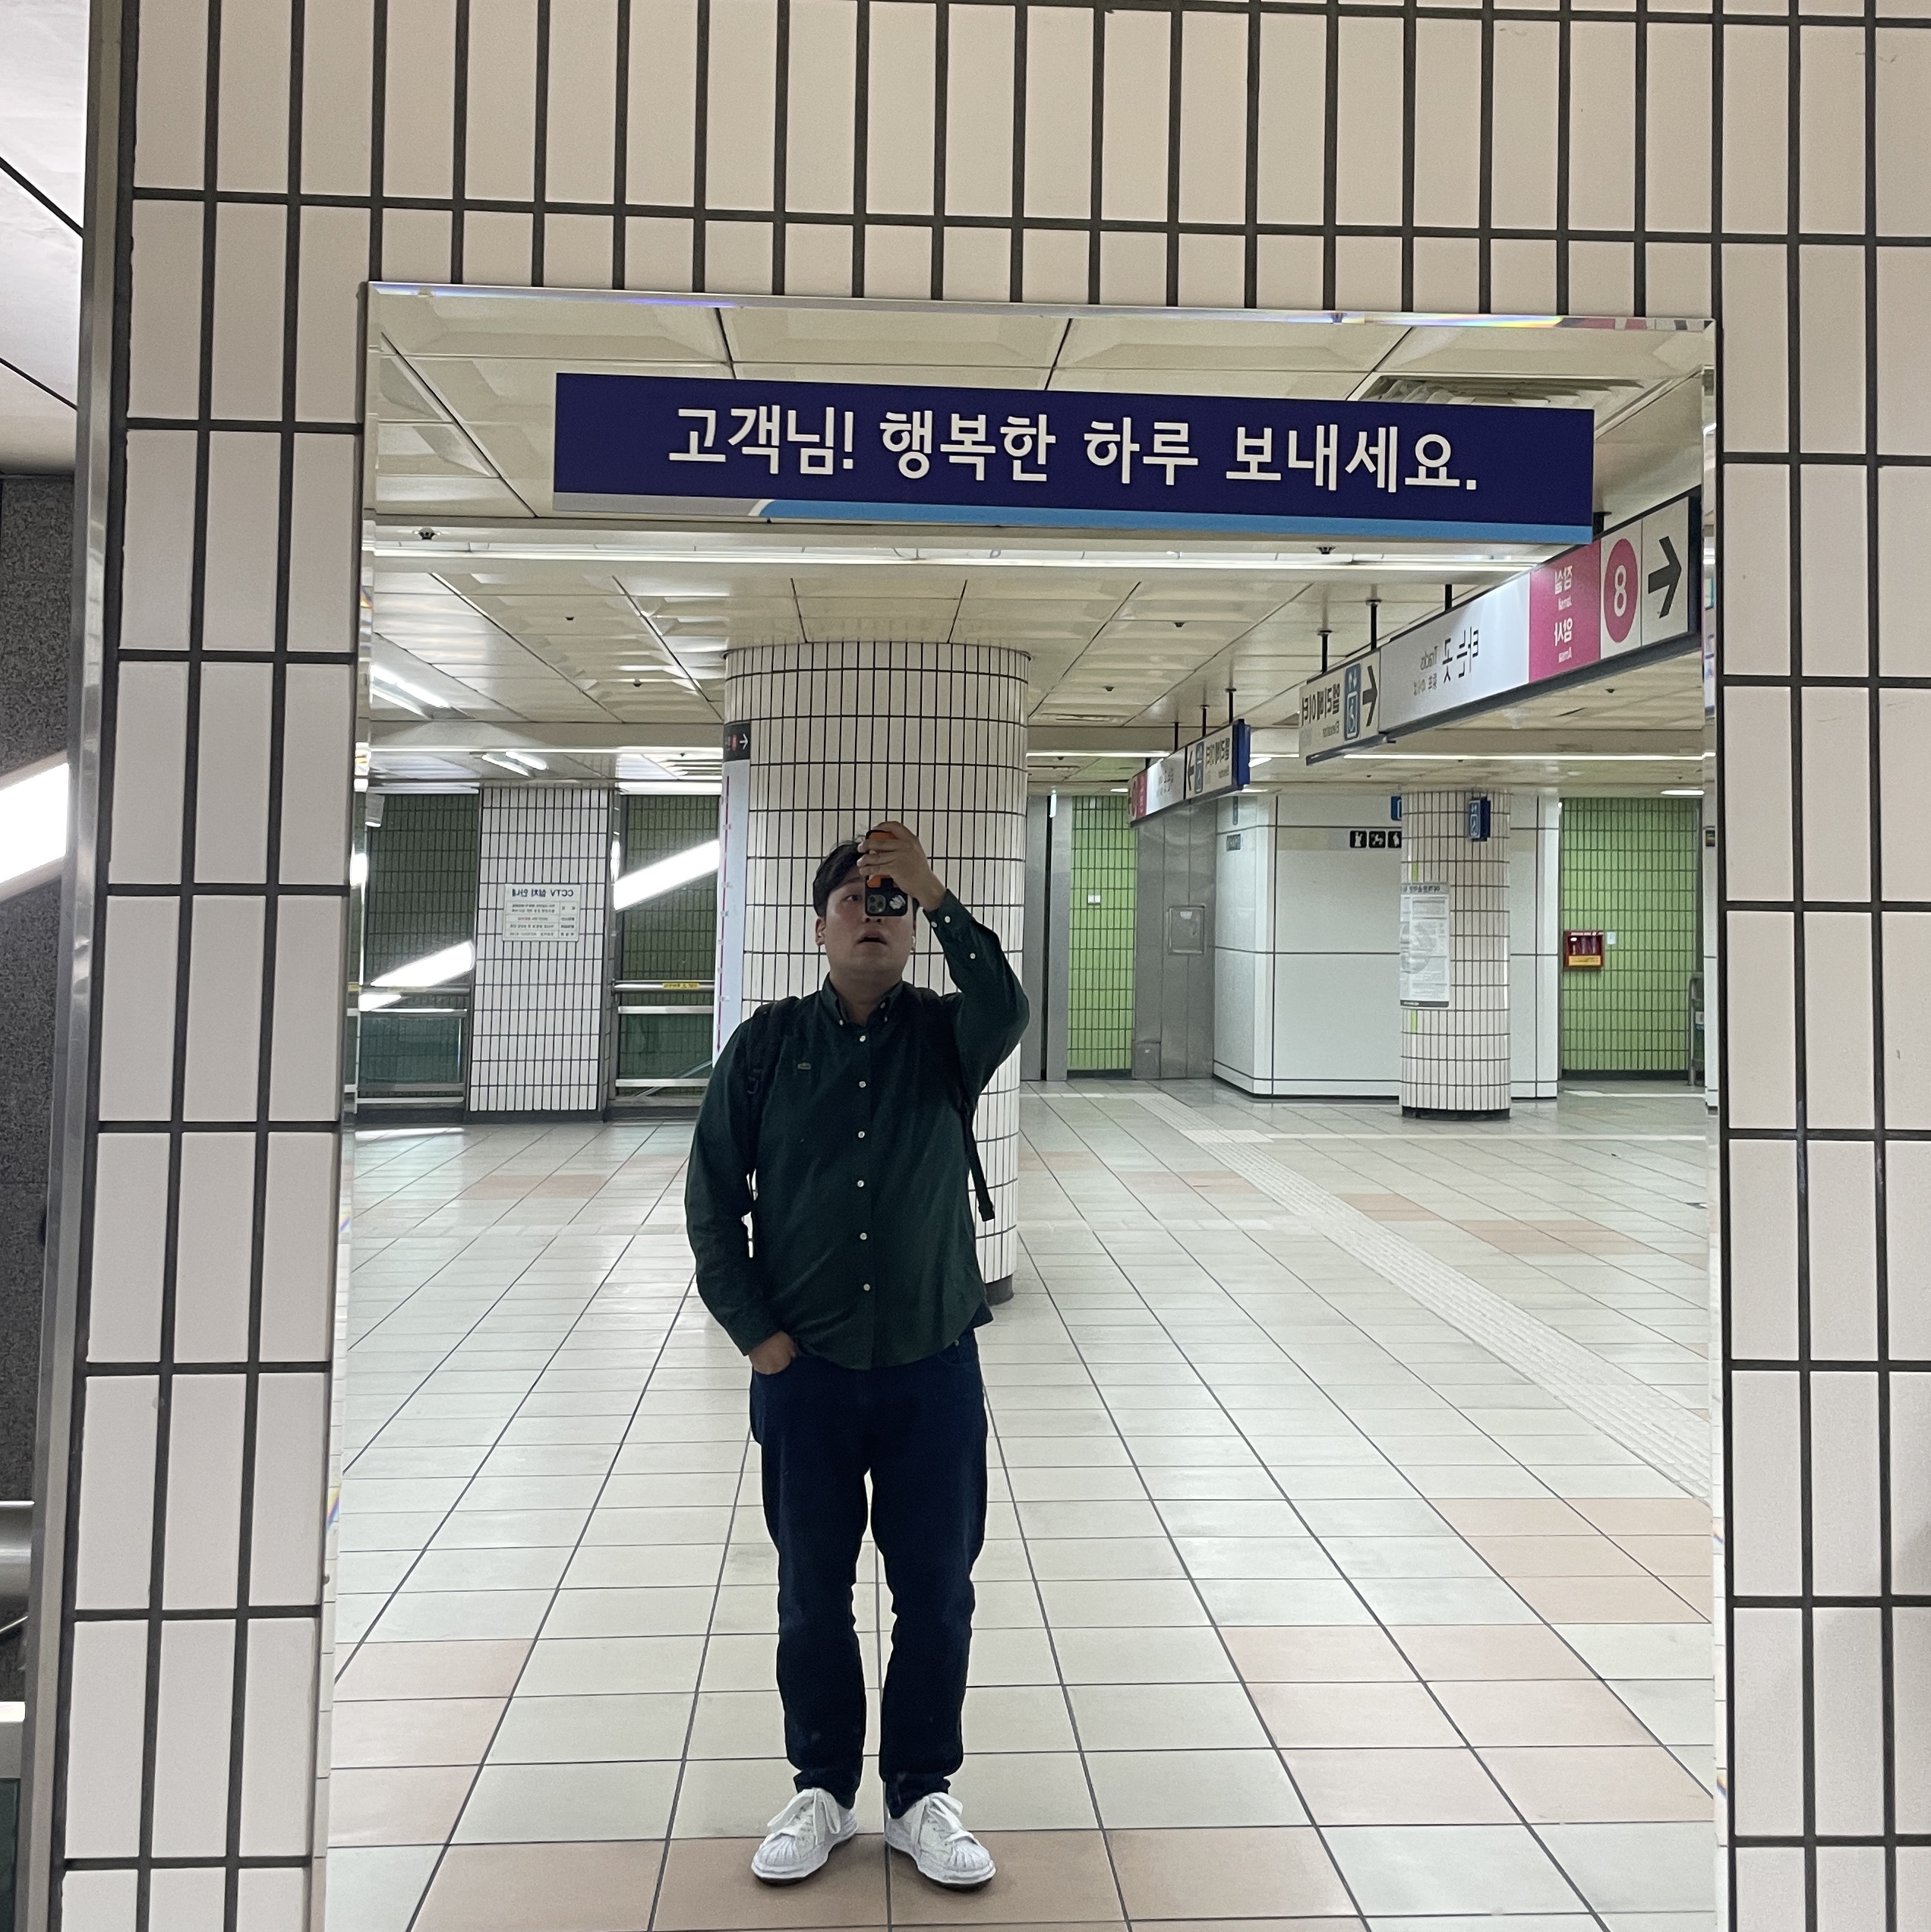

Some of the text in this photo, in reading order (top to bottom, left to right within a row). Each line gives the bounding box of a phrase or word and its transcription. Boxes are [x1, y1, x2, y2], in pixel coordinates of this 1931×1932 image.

[670, 406, 1476, 492] 고객님! 행복한 하루 보내세요.
